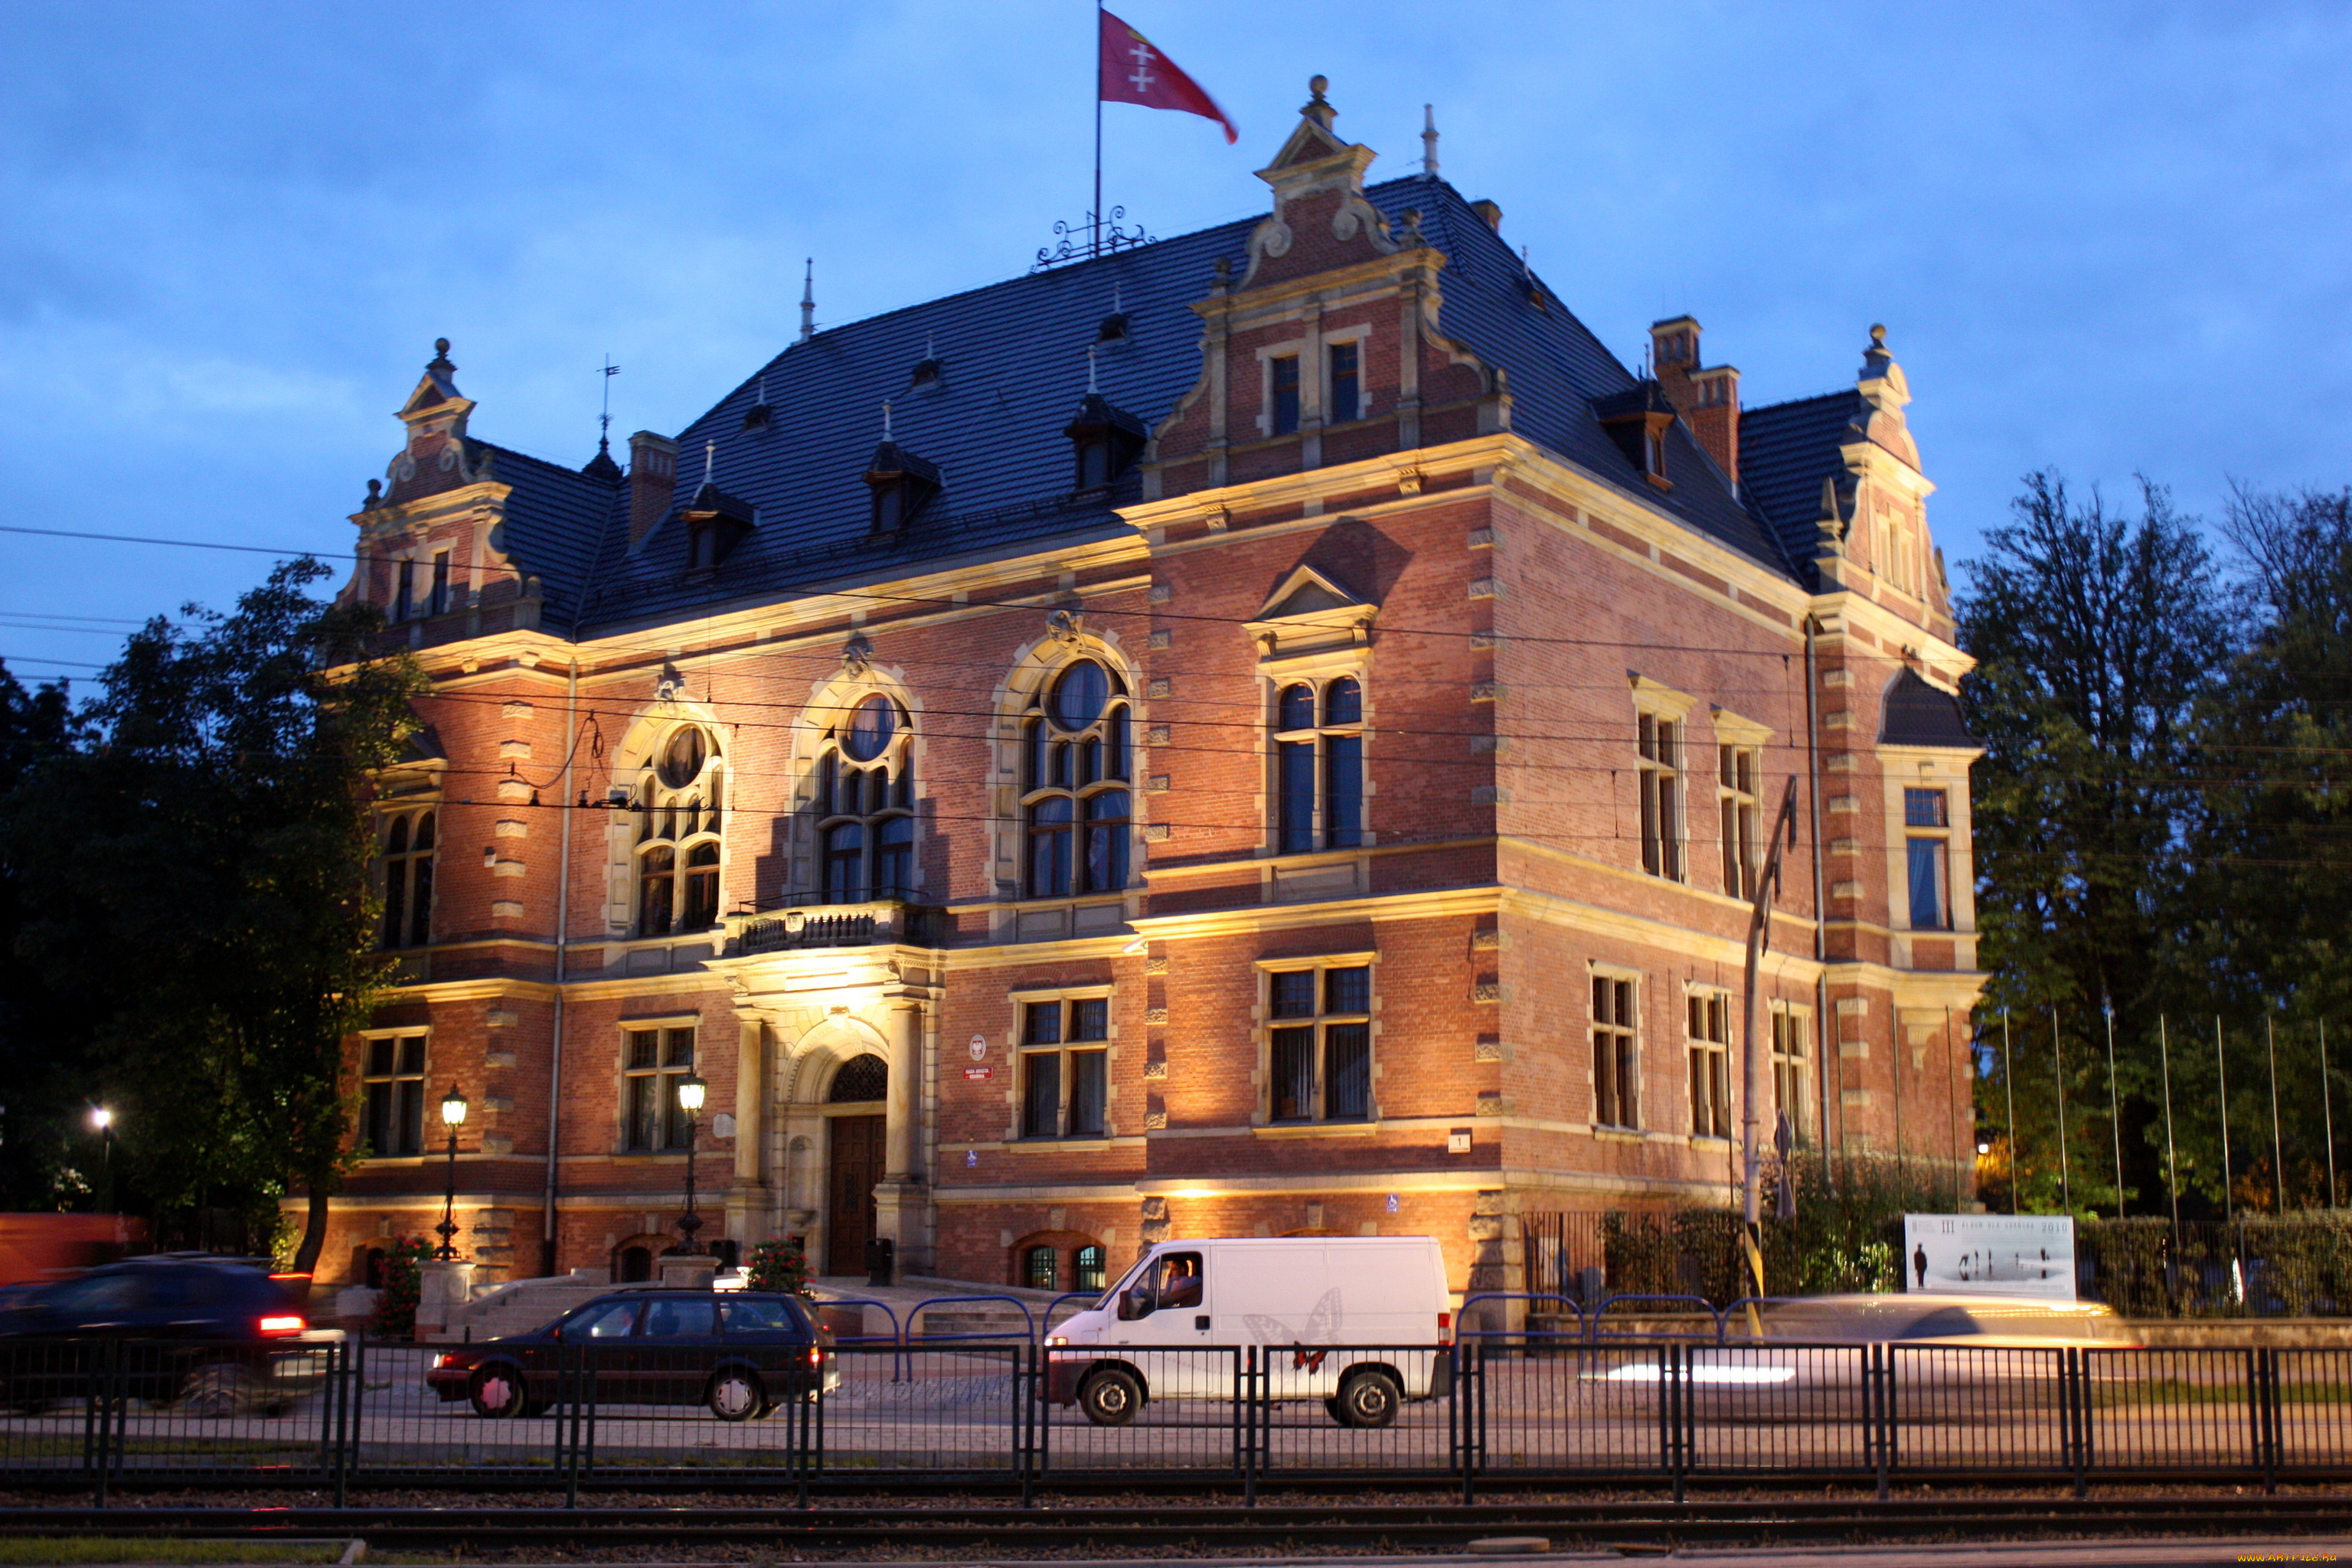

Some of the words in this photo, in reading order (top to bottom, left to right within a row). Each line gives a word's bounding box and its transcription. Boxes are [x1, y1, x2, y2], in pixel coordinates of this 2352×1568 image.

[1457, 1136, 1461, 1146] 1
[1942, 1220, 1954, 1233] III
[2041, 1222, 2067, 1233] 2010
